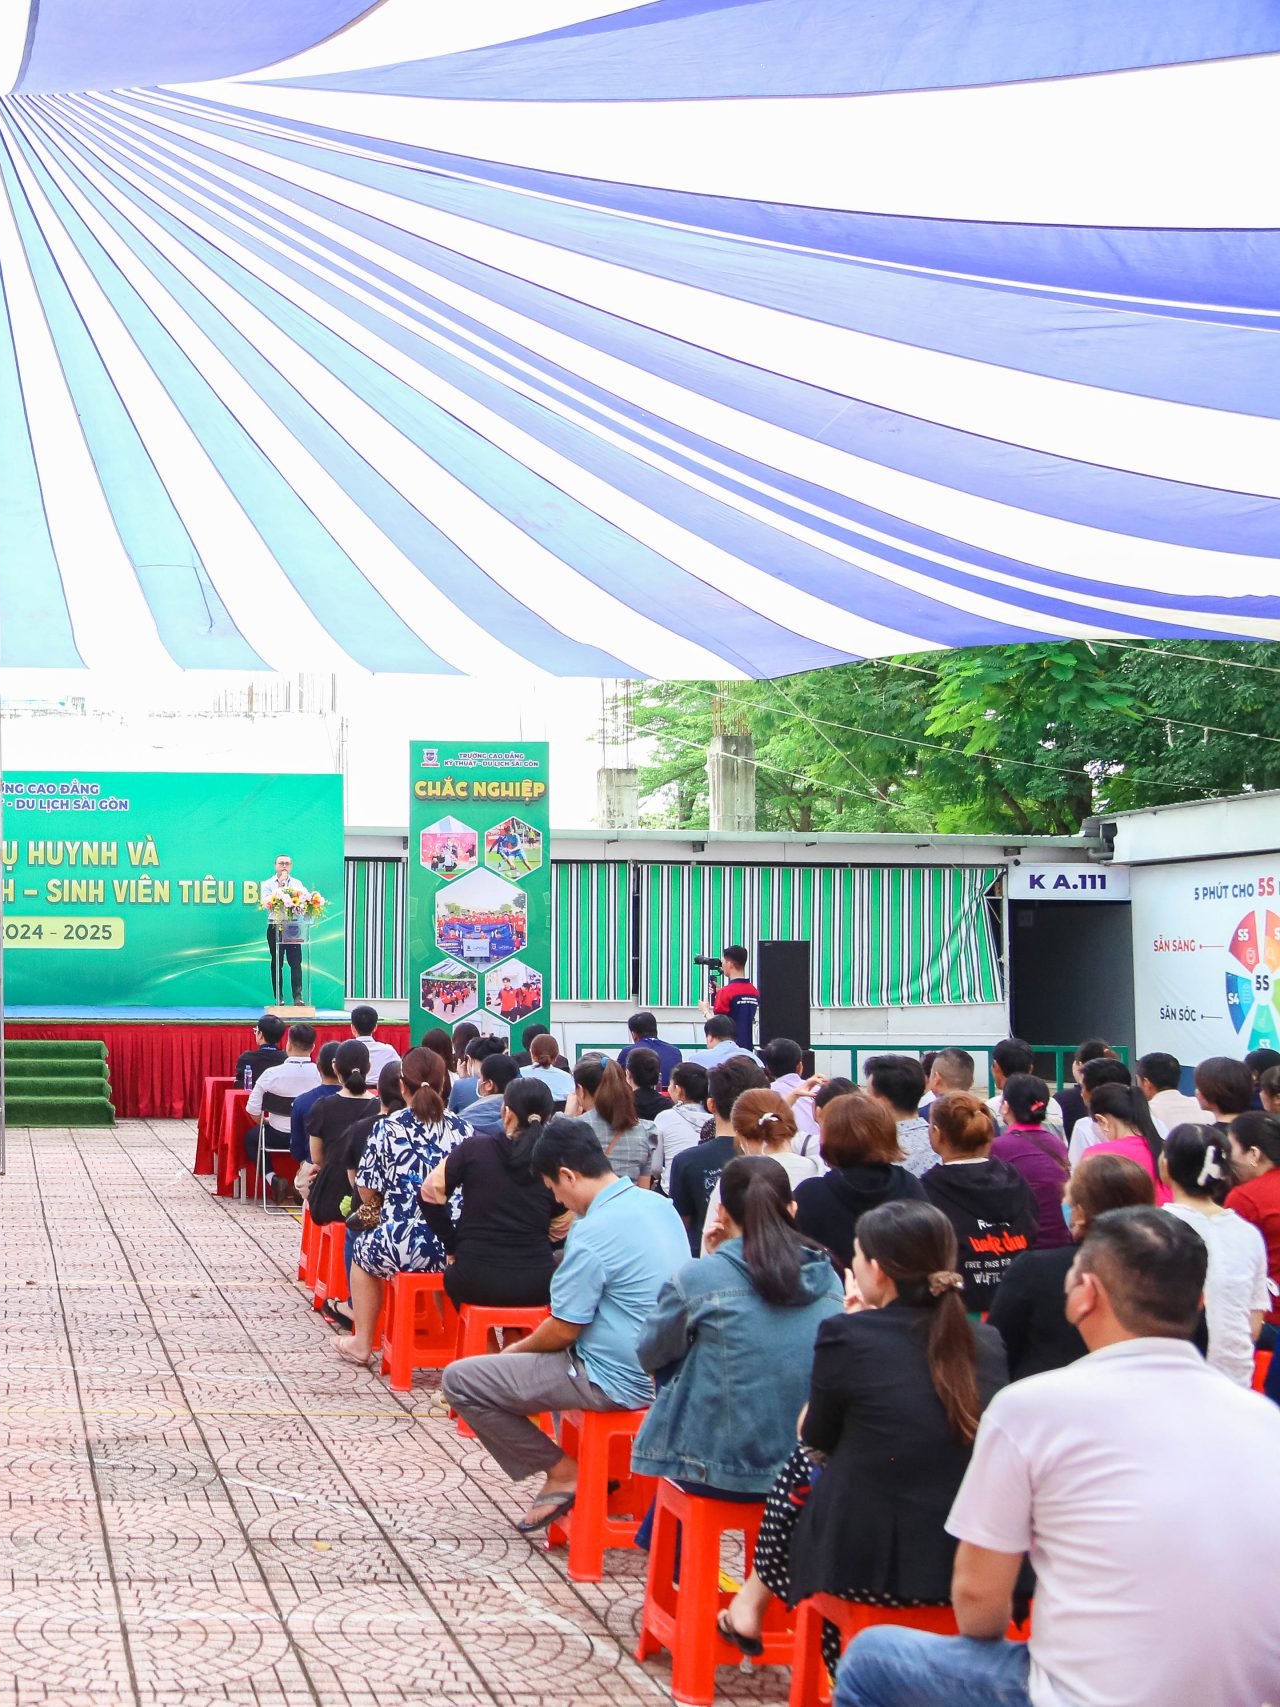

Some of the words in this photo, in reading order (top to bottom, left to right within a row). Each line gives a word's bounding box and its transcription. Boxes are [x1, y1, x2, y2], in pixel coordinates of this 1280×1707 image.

[27, 784, 56, 794] CAO
[60, 780, 99, 794] ĐẲNG
[414, 776, 468, 798] CHẮC
[473, 778, 546, 802] NGHIỆP
[16, 800, 35, 809] DU
[39, 800, 70, 812] LỊCH
[73, 797, 95, 810] SÀI
[99, 797, 128, 810] GÒN
[28, 840, 118, 867] HUYNH
[127, 834, 160, 867] VÀ
[46, 879, 105, 903] SINH
[112, 873, 170, 904] VIÊN
[178, 875, 235, 904] TIÊU
[1029, 874, 1046, 890] K
[1052, 874, 1107, 890] A.111
[1194, 887, 1200, 901] 5
[1202, 882, 1229, 900] PHÚT
[1232, 883, 1255, 898] CHO
[1258, 876, 1275, 897] 5S
[63, 924, 112, 940] 2025
[1237, 928, 1250, 942] S5
[1255, 974, 1270, 991] 5S
[1227, 992, 1240, 1005] S4
